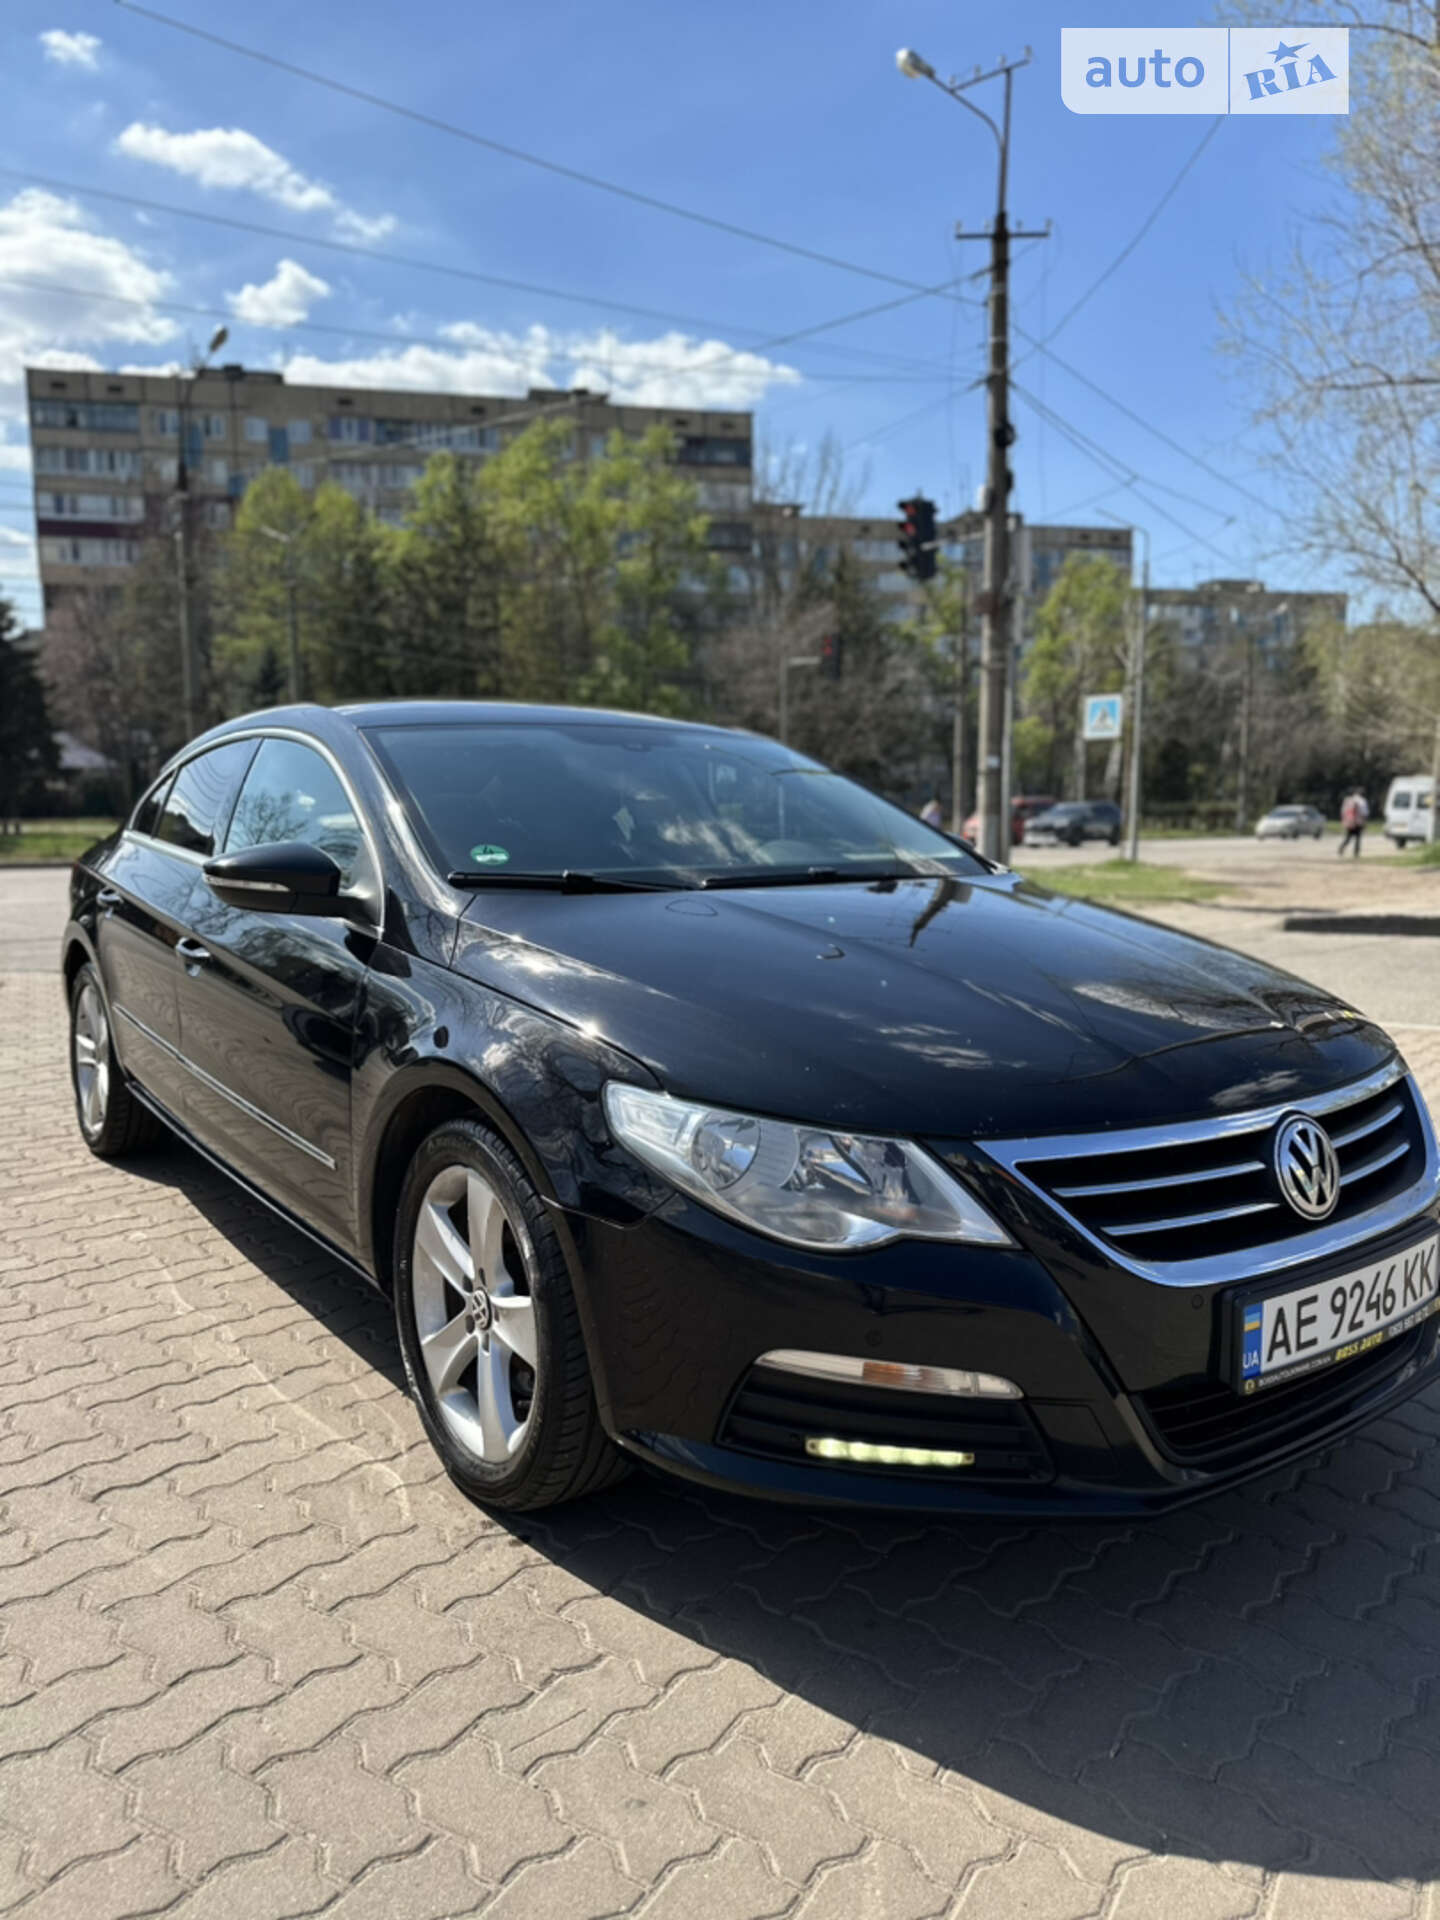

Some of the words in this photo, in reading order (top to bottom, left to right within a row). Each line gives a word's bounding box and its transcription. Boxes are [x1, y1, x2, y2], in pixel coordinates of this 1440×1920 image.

[1266, 1294, 1319, 1362] AE
[1330, 1263, 1396, 1340] 9246
[1402, 1243, 1437, 1308] KK
[1243, 1350, 1260, 1369] UA
